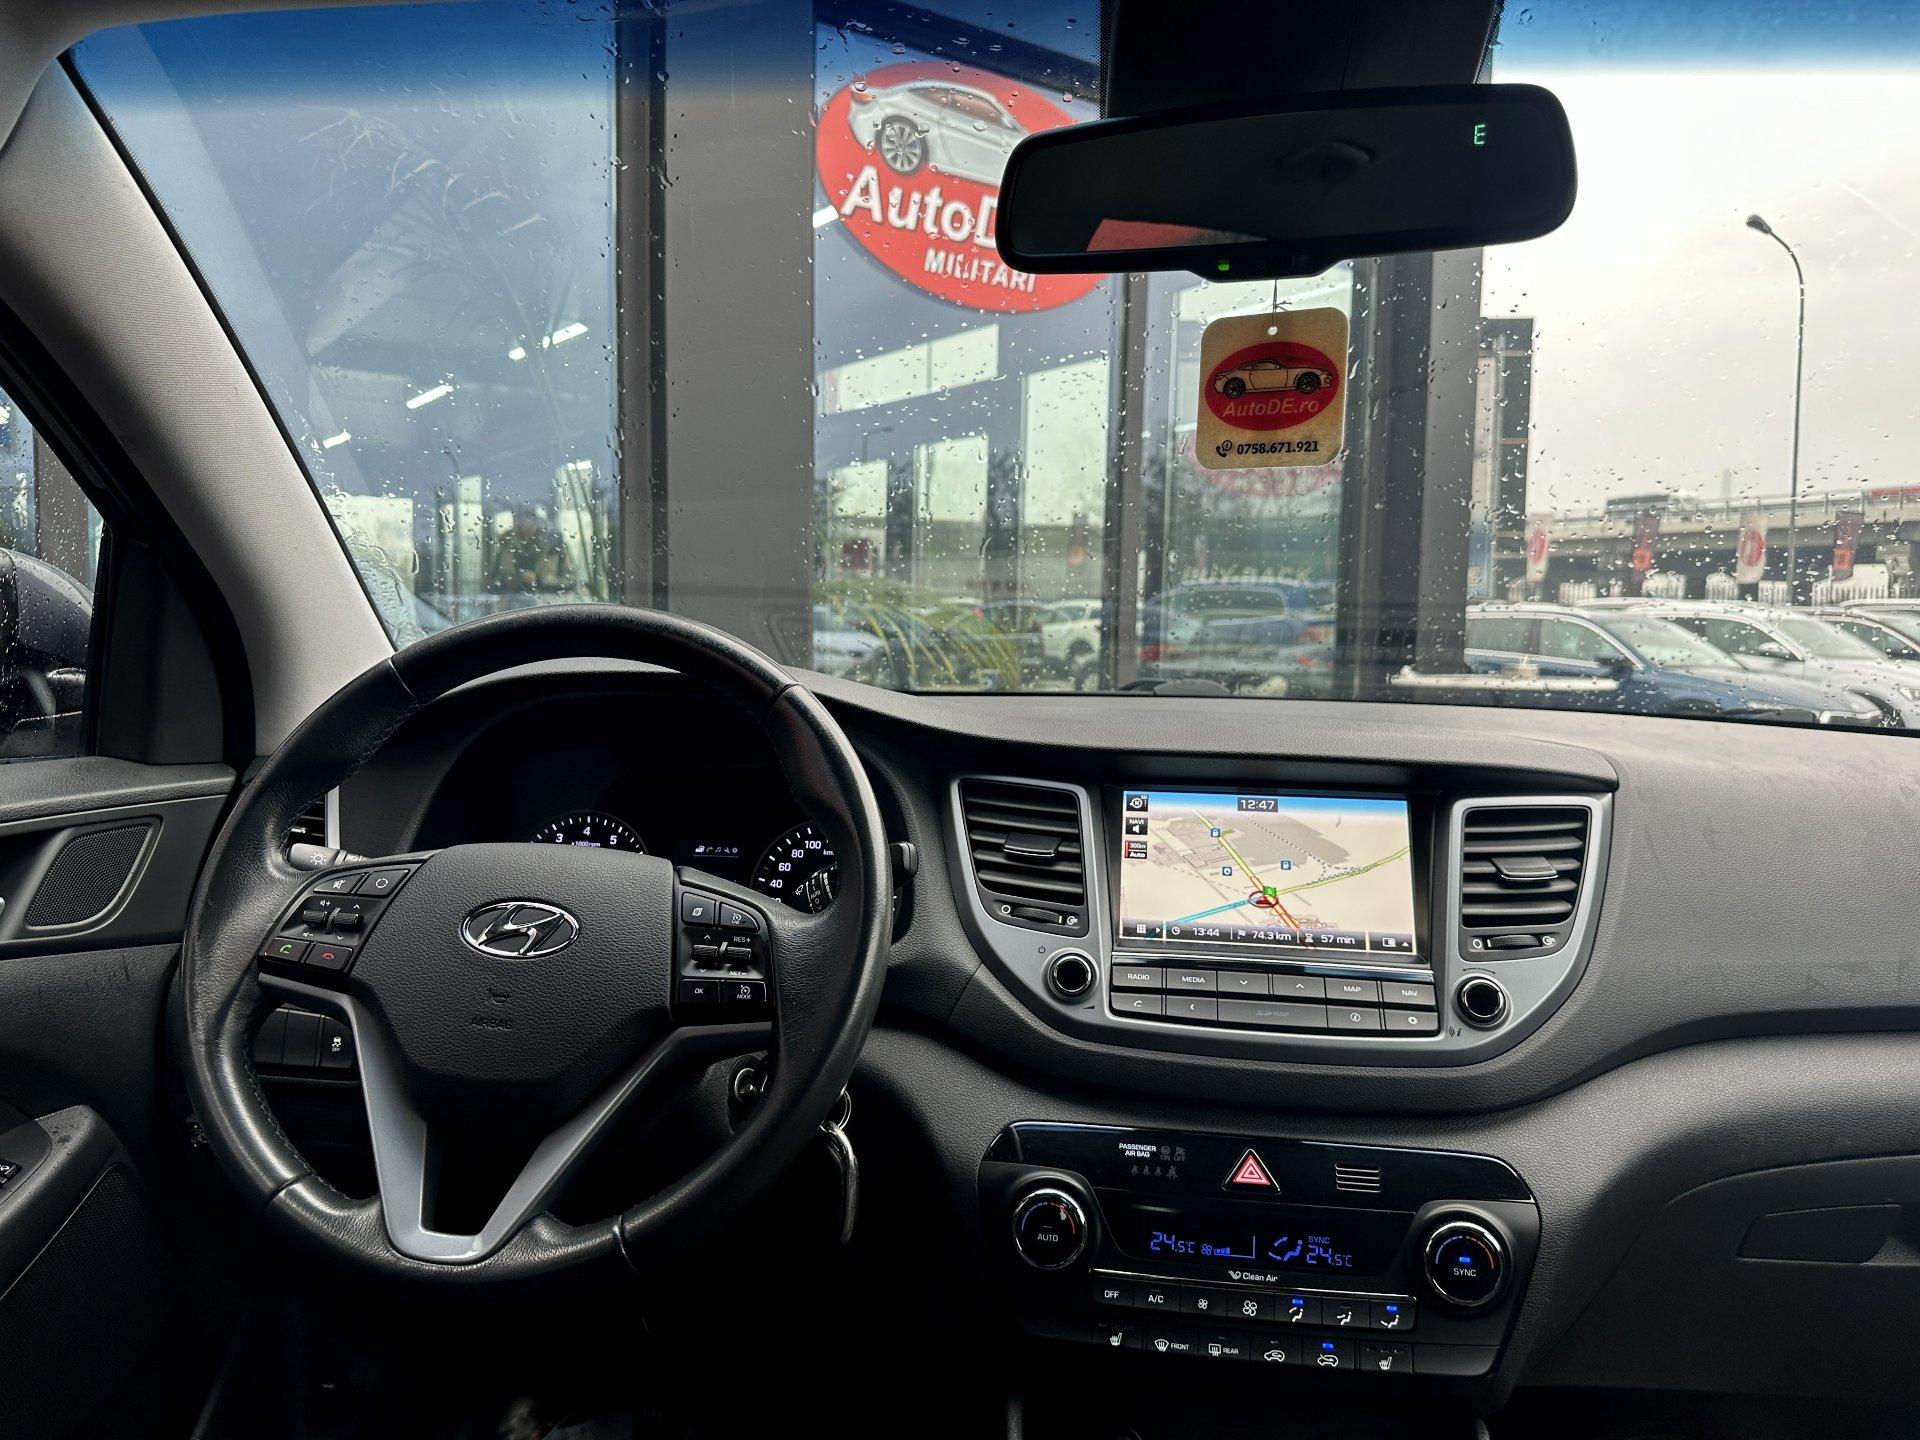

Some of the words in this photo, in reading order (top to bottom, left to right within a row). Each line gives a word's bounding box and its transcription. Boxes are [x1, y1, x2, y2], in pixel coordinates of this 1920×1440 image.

[1474, 124, 1486, 145] E
[923, 247, 1036, 293] MILITARI
[1222, 396, 1320, 418] AutoDE.ro
[1236, 440, 1320, 455] 0758.671.921
[1240, 799, 1275, 810] 12:47
[583, 826, 591, 836] 4
[555, 833, 564, 843] 3
[609, 835, 618, 845] 5
[804, 840, 822, 850] 100
[791, 849, 804, 858] 80
[778, 862, 791, 872] 60
[769, 879, 783, 889] 40
[1192, 927, 1220, 937] 13:44
[1251, 930, 1275, 940] 74.3
[1275, 931, 1292, 941] km
[1320, 934, 1334, 943] 57
[1336, 935, 1356, 945] min
[1127, 973, 1150, 981] RADIO
[1181, 975, 1205, 984] MEDIA
[1343, 984, 1362, 993] MAP
[1401, 989, 1418, 998] NAV
[1118, 1142, 1157, 1152] PASSENGER
[1125, 1149, 1136, 1157] AIR
[1136, 1150, 1151, 1158] BAG
[1037, 1233, 1059, 1242] AUTO
[1308, 1235, 1331, 1244] SYNC
[1242, 1272, 1264, 1281] Clean
[1265, 1274, 1279, 1282] Air
[1453, 1268, 1477, 1278] SYNC
[1104, 1290, 1120, 1299] OFF
[1148, 1294, 1164, 1304] A/C
[1170, 1342, 1190, 1351] FRONT
[1222, 1346, 1239, 1355] REAR
